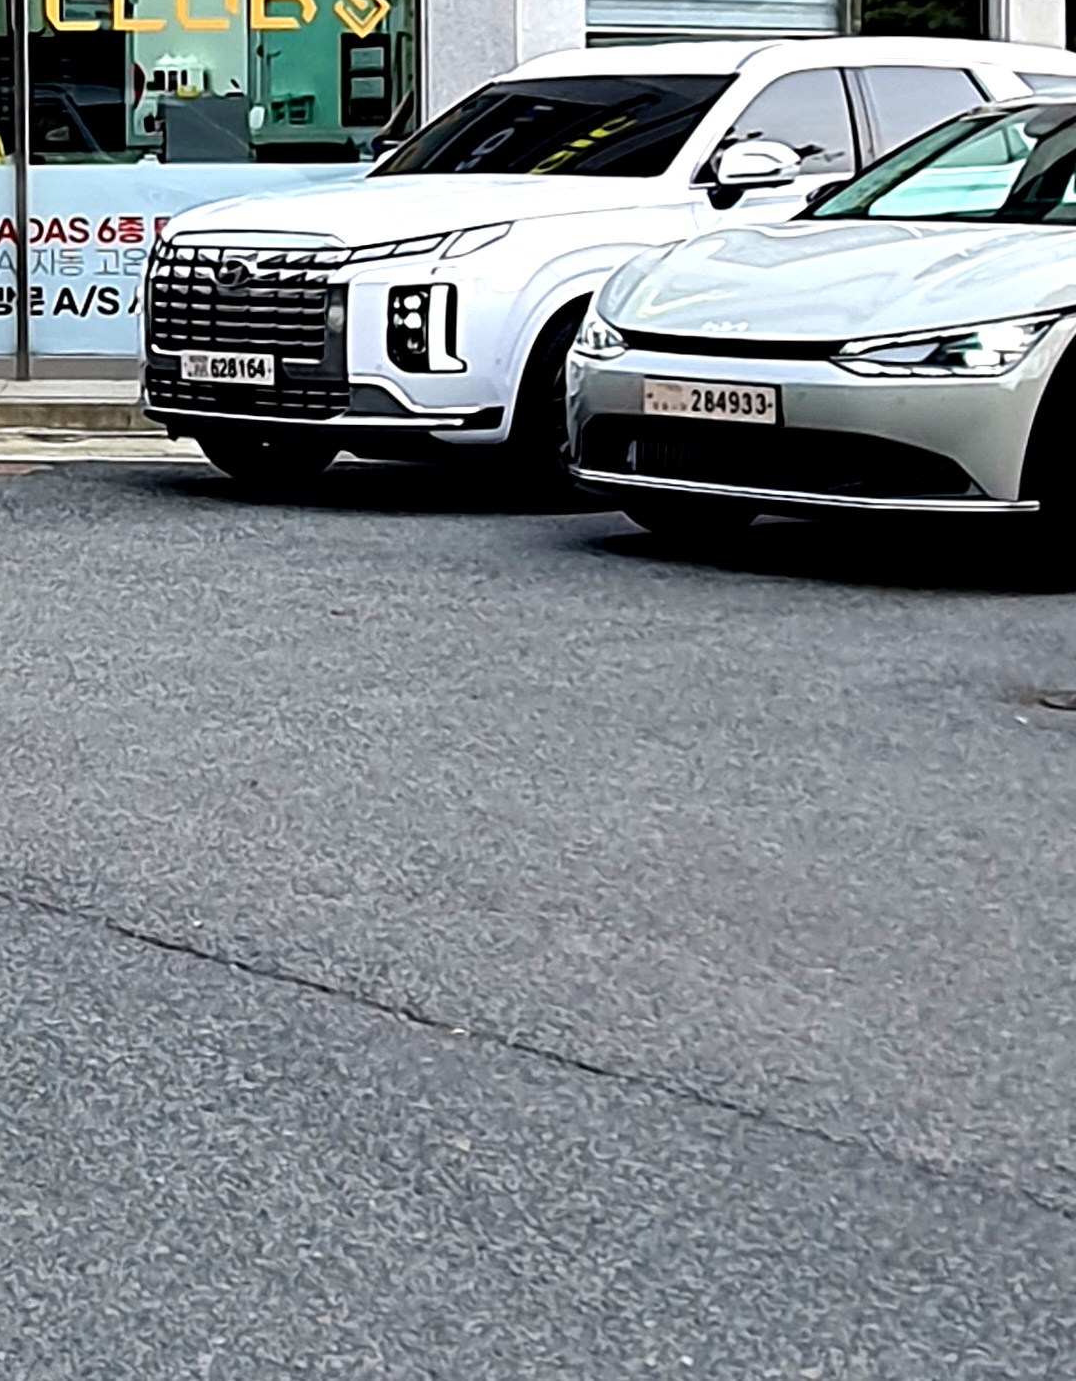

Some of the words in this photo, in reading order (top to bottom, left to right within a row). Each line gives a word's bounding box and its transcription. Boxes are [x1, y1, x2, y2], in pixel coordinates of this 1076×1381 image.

[97, 216, 145, 244] 6종
[31, 248, 85, 277] 자동
[53, 285, 120, 317] A/S
[211, 357, 265, 378] 628164
[691, 389, 766, 415] 284933
